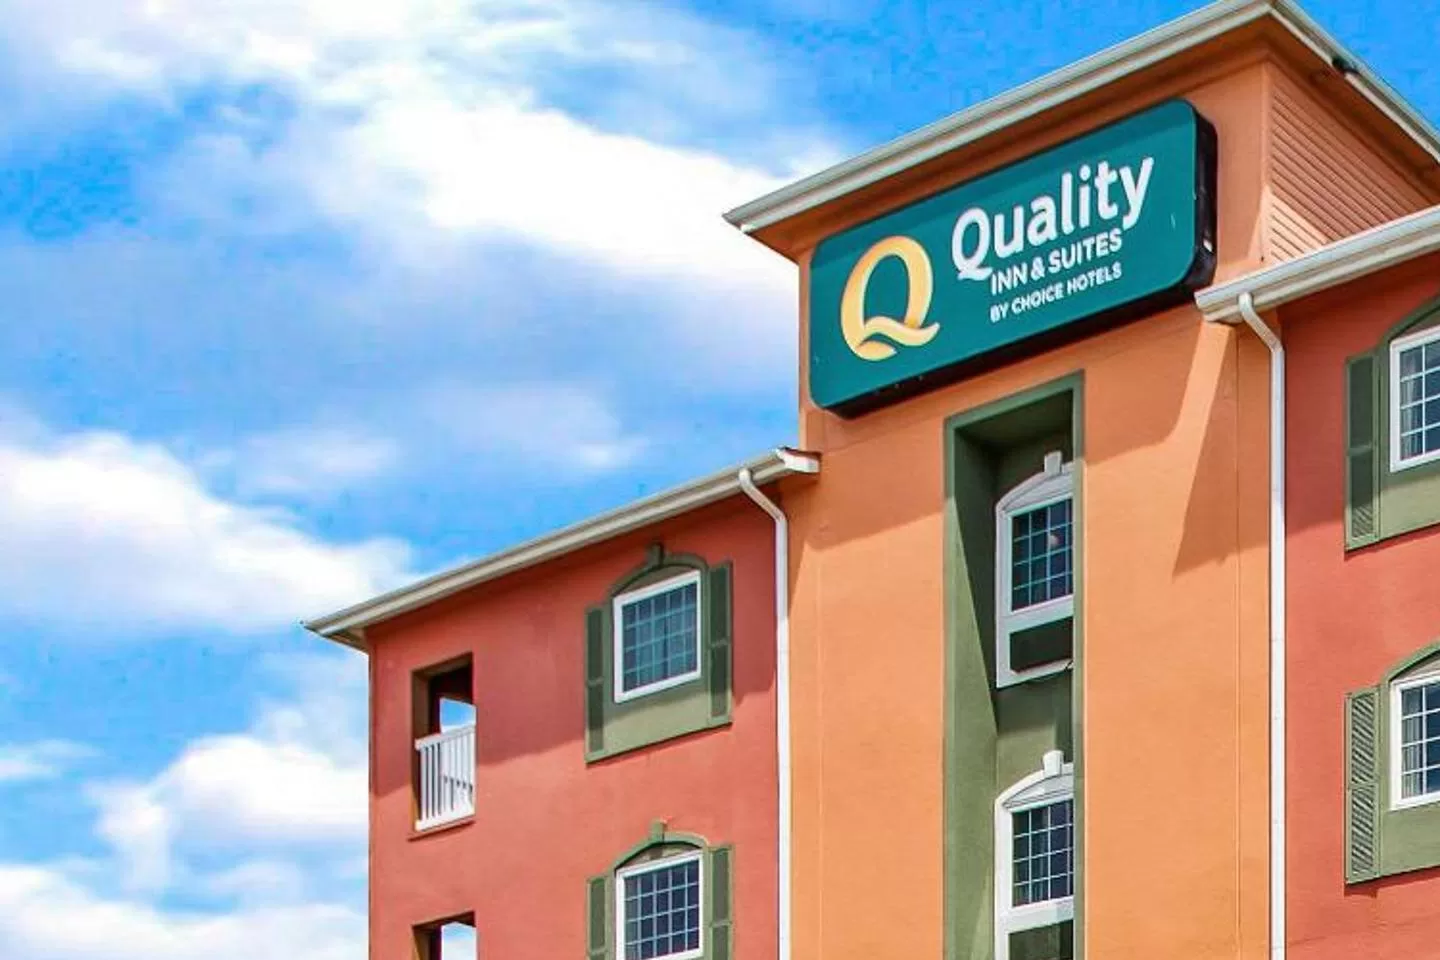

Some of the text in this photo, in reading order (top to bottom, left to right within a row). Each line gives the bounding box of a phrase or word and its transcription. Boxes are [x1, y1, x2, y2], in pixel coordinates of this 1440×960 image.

[951, 156, 1154, 281] Quality
[990, 227, 1123, 296] INN & SUITES
[839, 235, 940, 362] Q
[989, 261, 1123, 323] BY CHOICE HOTELS
